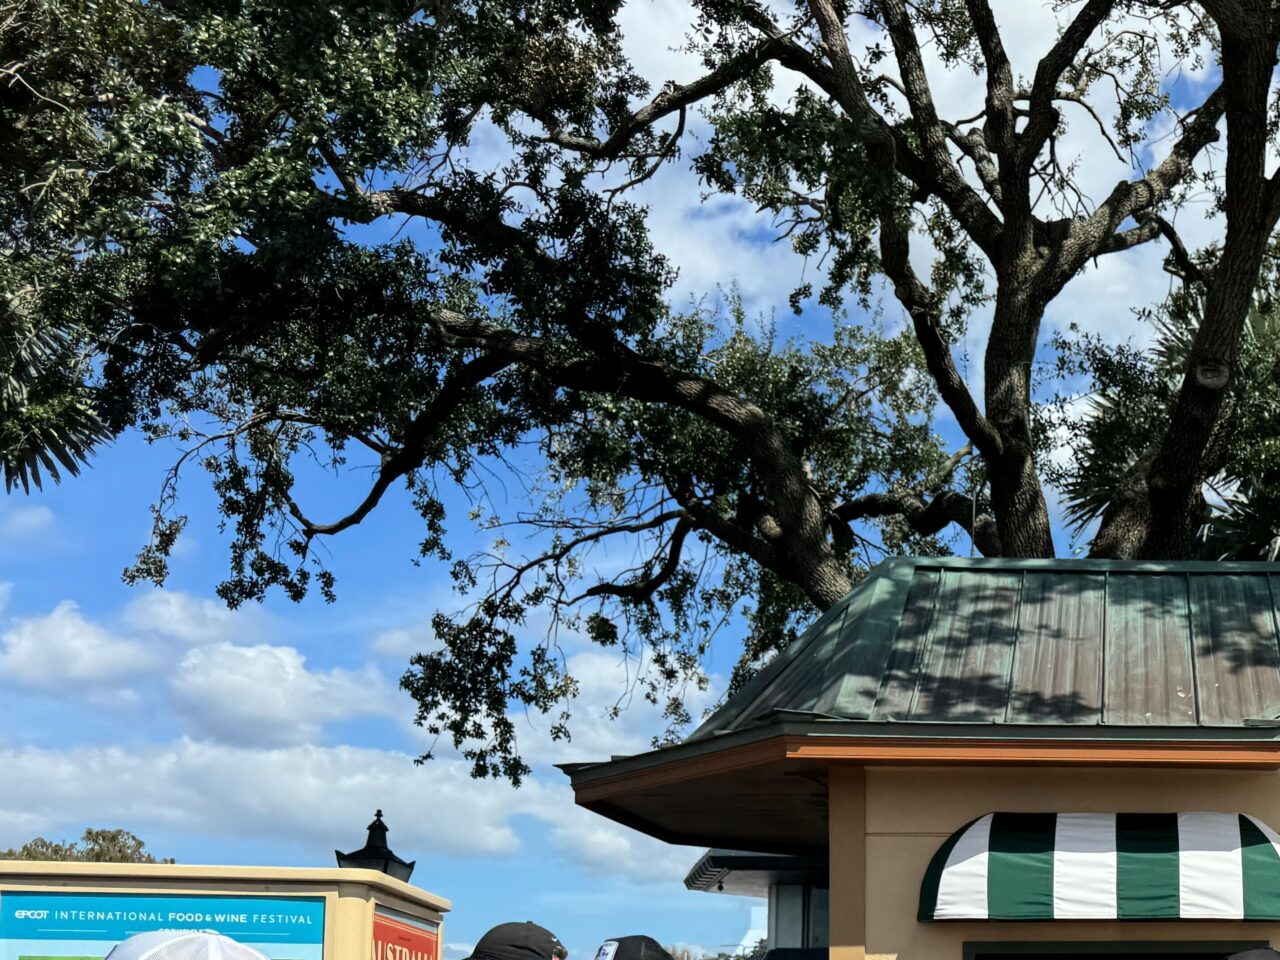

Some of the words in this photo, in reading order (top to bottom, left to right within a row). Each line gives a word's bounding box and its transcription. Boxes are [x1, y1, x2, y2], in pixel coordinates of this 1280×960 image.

[14, 909, 50, 919] EPCOT
[54, 910, 165, 922] INTERNATIONAL
[168, 912, 203, 922] FOOD
[205, 913, 212, 922] &
[214, 913, 248, 923] WINE
[252, 914, 313, 925] FESTIVAL
